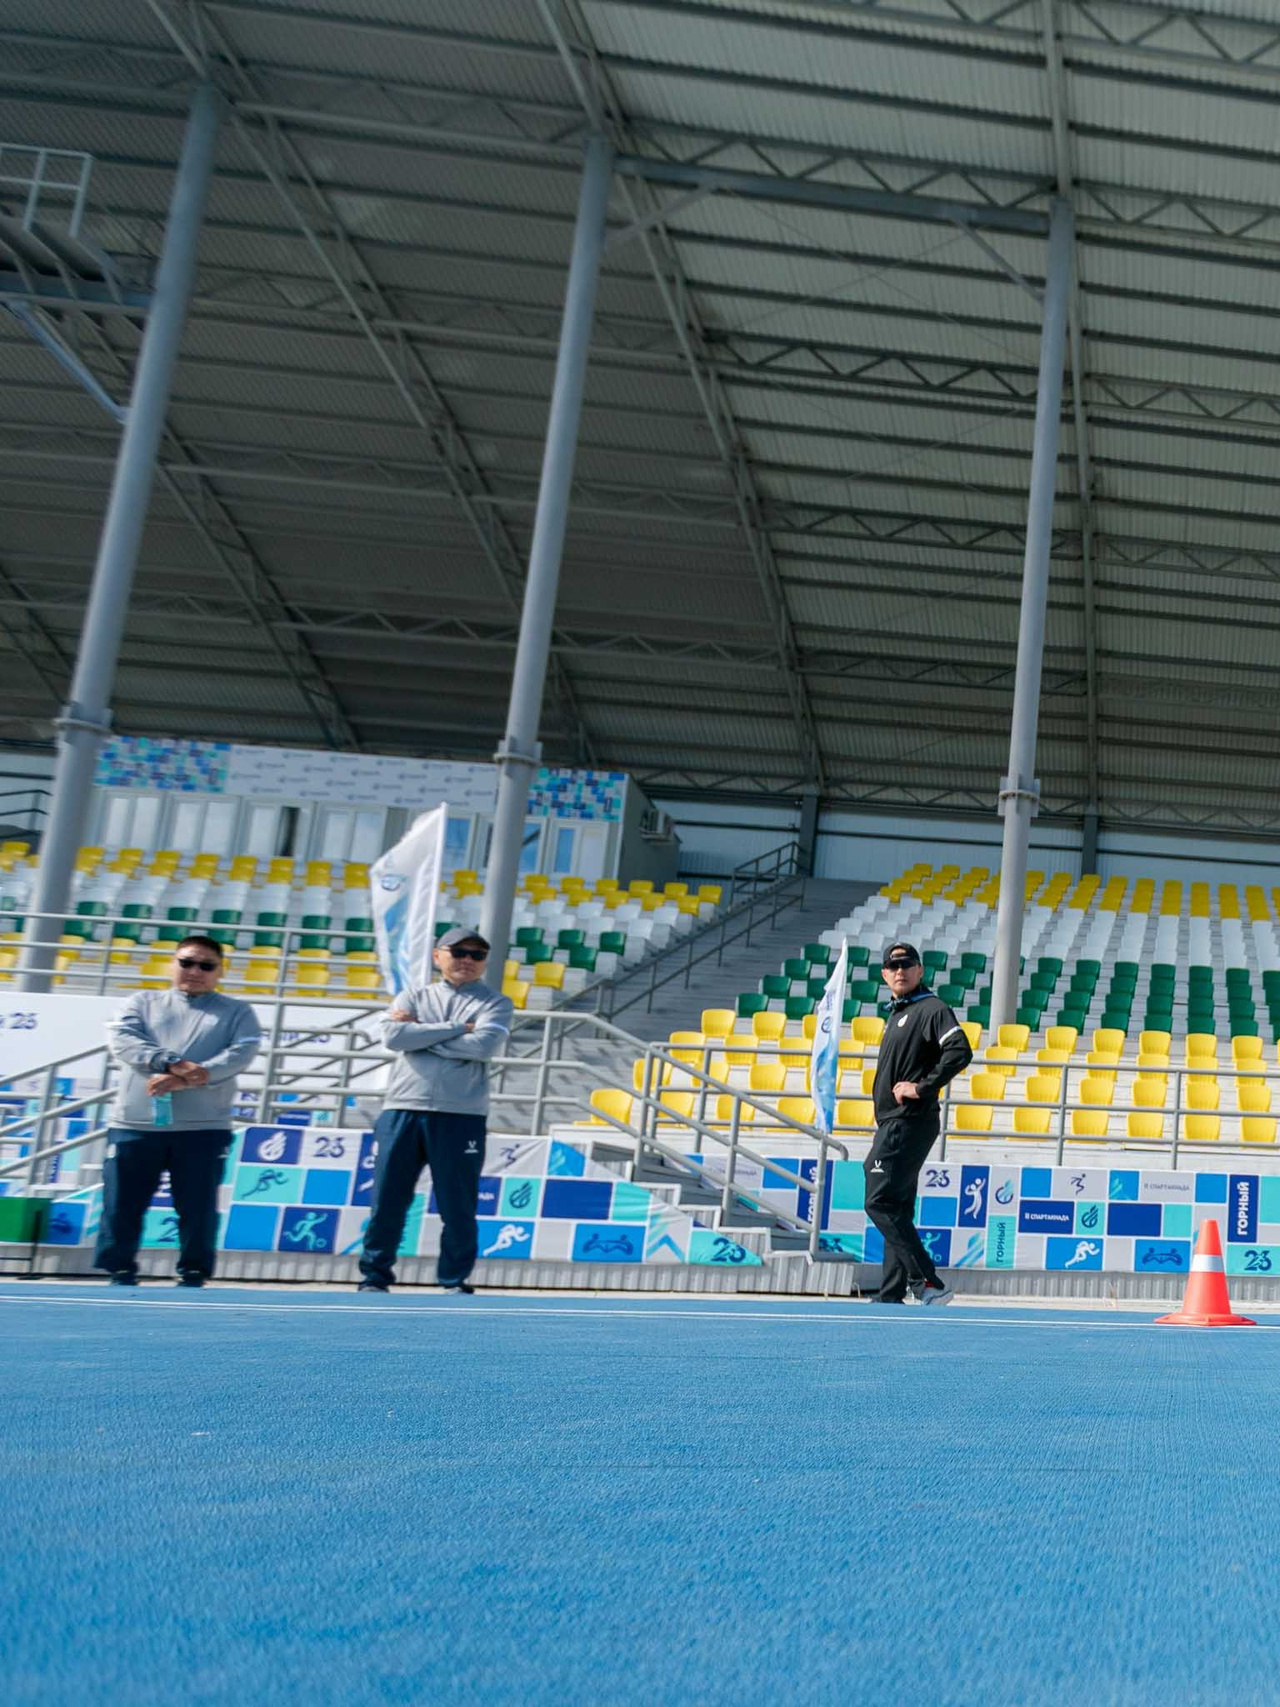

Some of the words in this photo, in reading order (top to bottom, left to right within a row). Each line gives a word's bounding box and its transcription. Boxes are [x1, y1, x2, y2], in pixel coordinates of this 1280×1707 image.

[313, 1136, 345, 1158] 23
[925, 1169, 951, 1188] 23
[1236, 1181, 1250, 1236] ГОРНЫЙ
[711, 1236, 746, 1263] 23
[996, 1222, 1006, 1263] ГОРНЫЙ
[1244, 1250, 1272, 1271] 23
